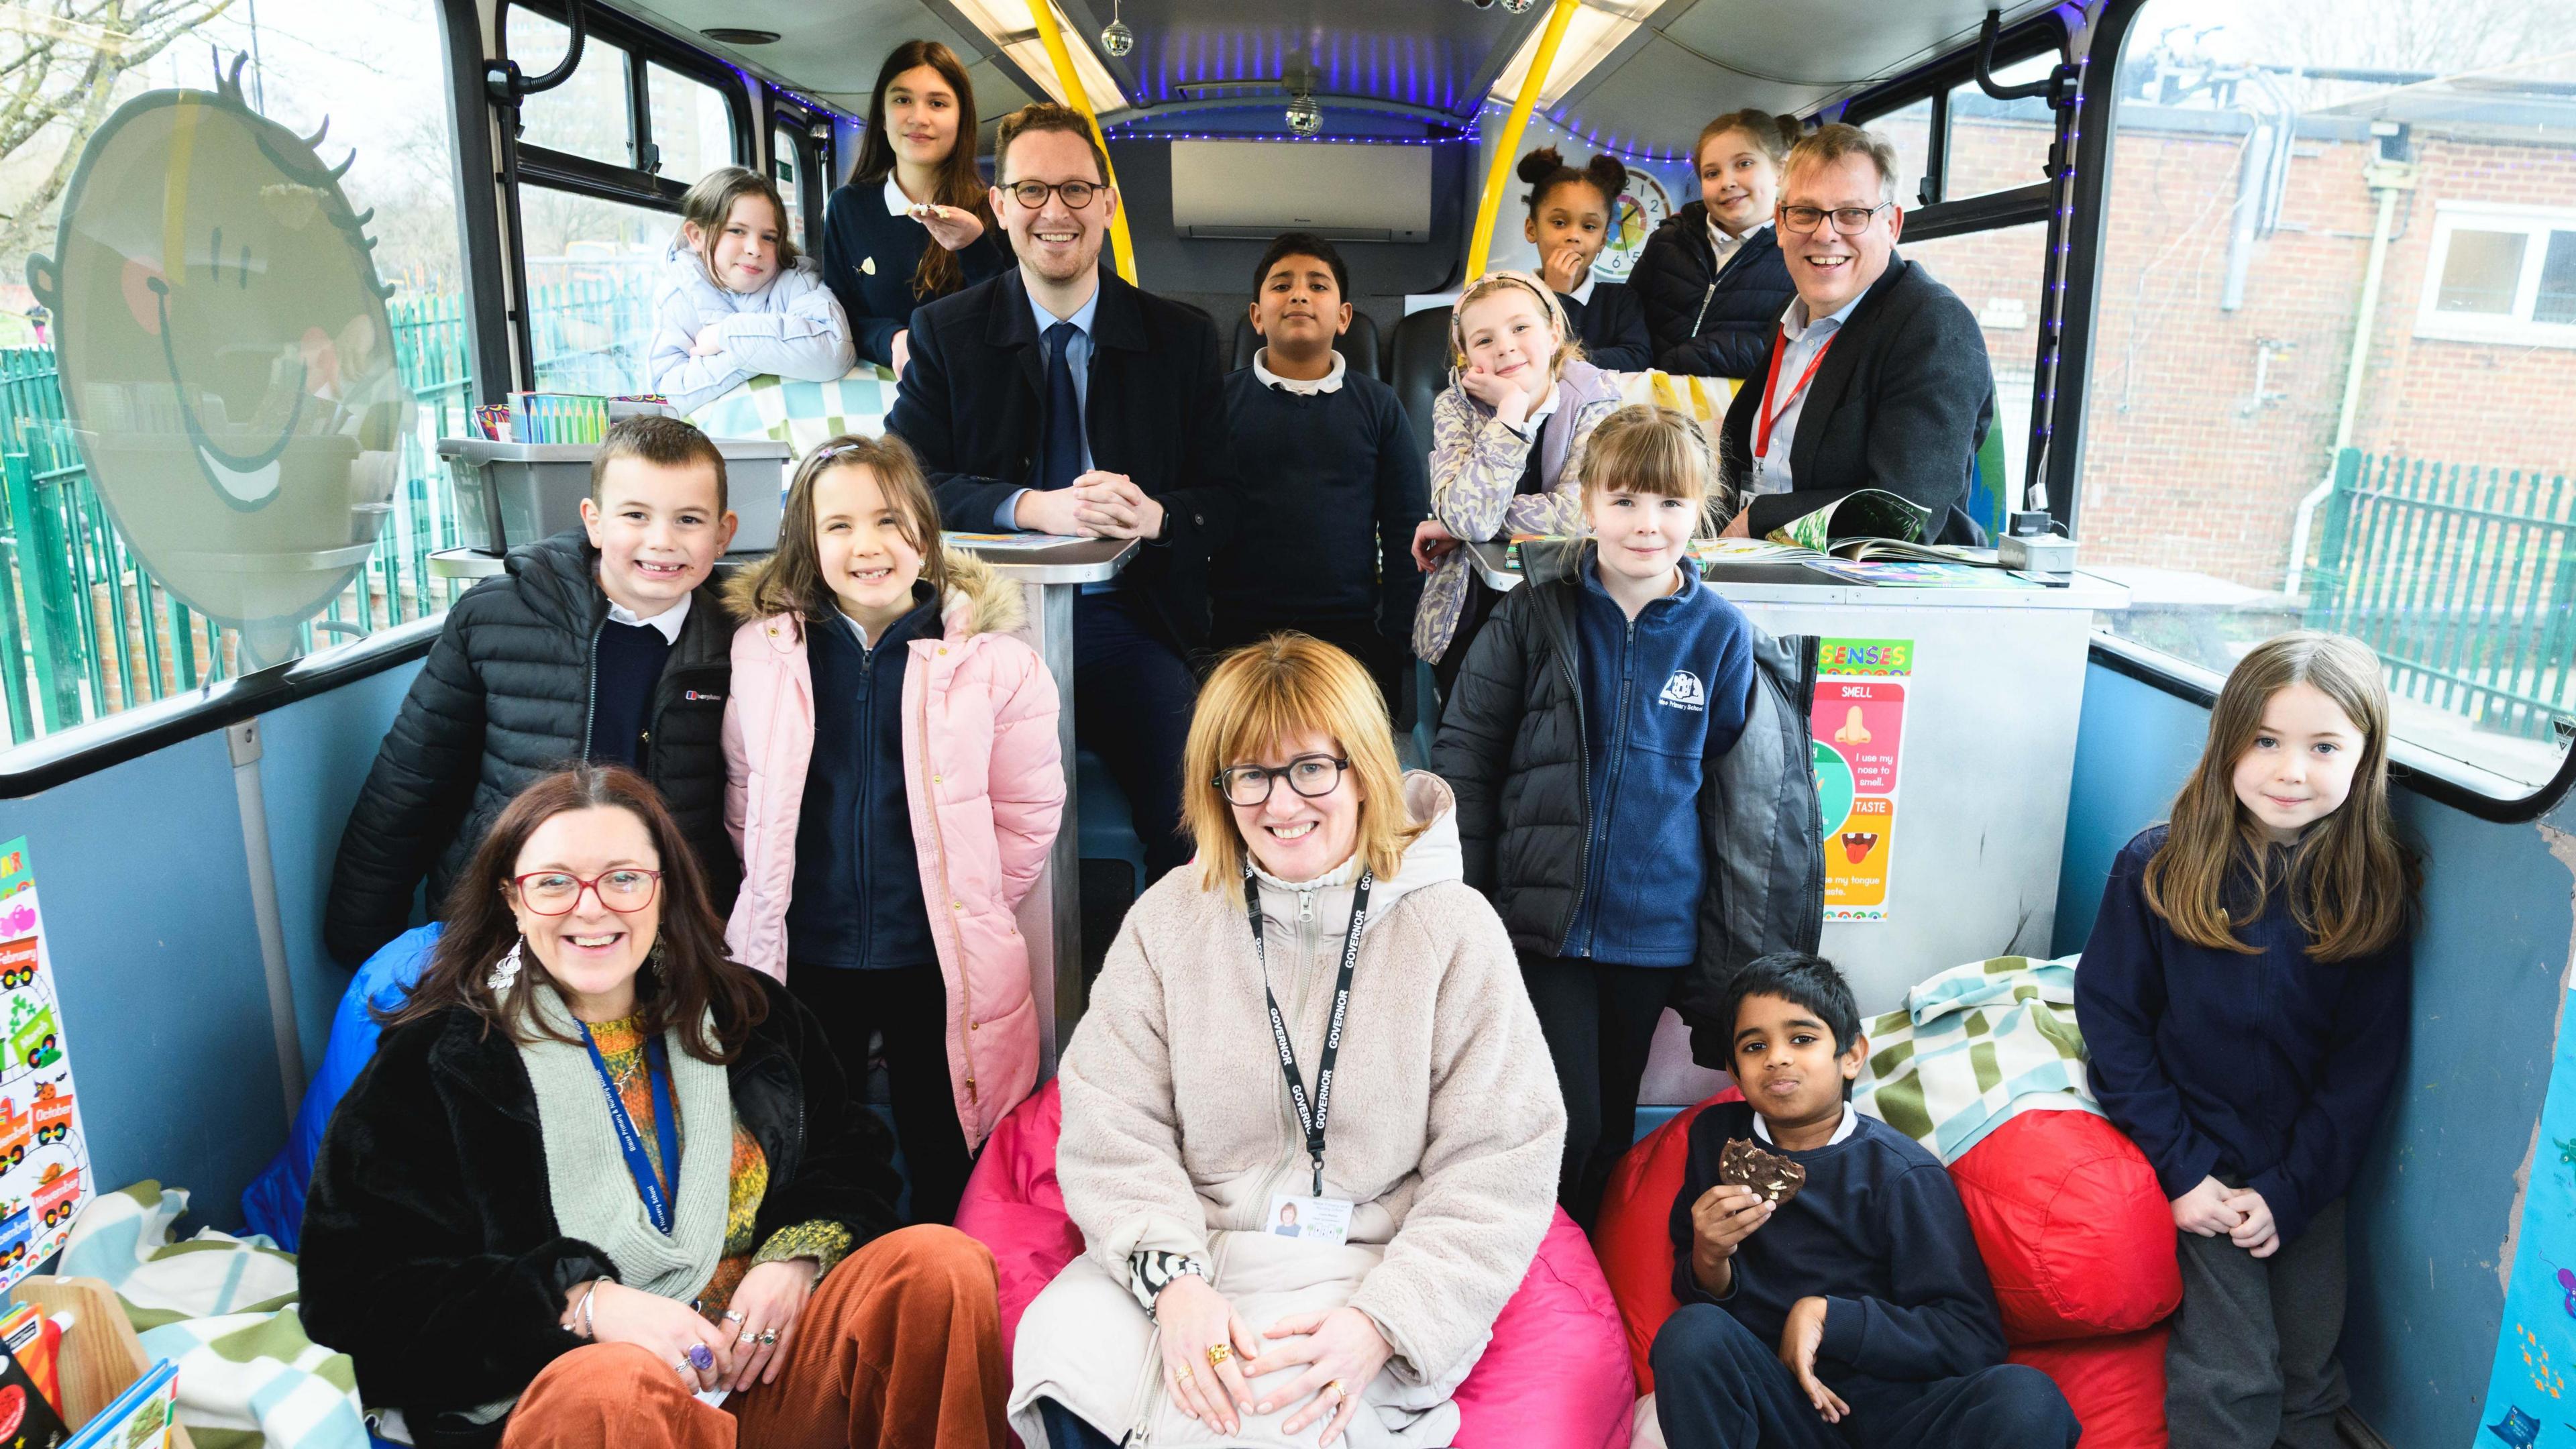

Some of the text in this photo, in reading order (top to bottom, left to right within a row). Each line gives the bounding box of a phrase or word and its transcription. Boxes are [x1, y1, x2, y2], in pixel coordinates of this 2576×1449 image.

[1650, 199, 1660, 213] 2
[1612, 255, 1621, 268] 6
[1821, 645, 1906, 666] SENSES
[1841, 686, 1873, 698] SMELL
[1669, 700, 1687, 711] Primary
[1686, 704, 1703, 712] School
[1856, 753, 1860, 762] I
[1879, 755, 1893, 765] my
[1881, 766, 1890, 775] to
[1859, 777, 1884, 786] smell.
[1856, 801, 1886, 813] TASTE
[0, 851, 23, 878] AR
[1835, 877, 1848, 886] my
[1851, 875, 1880, 886] tongue
[1345, 910, 1365, 969] GOVERNOR
[1329, 989, 1348, 1049] GOVERNOR
[19, 1020, 49, 1050] March
[1270, 1008, 1292, 1066] GOVERNOR
[603, 1087, 616, 1109] Nursery
[1316, 1069, 1332, 1129] GOVERNOR
[36, 1104, 70, 1122] October
[1292, 1084, 1312, 1134] GOVERN
[616, 1114, 629, 1136] Primary
[625, 1135, 637, 1152] Blaise
[36, 1178, 78, 1208] November
[647, 1185, 659, 1205] School
[655, 1203, 666, 1227] Nursery
